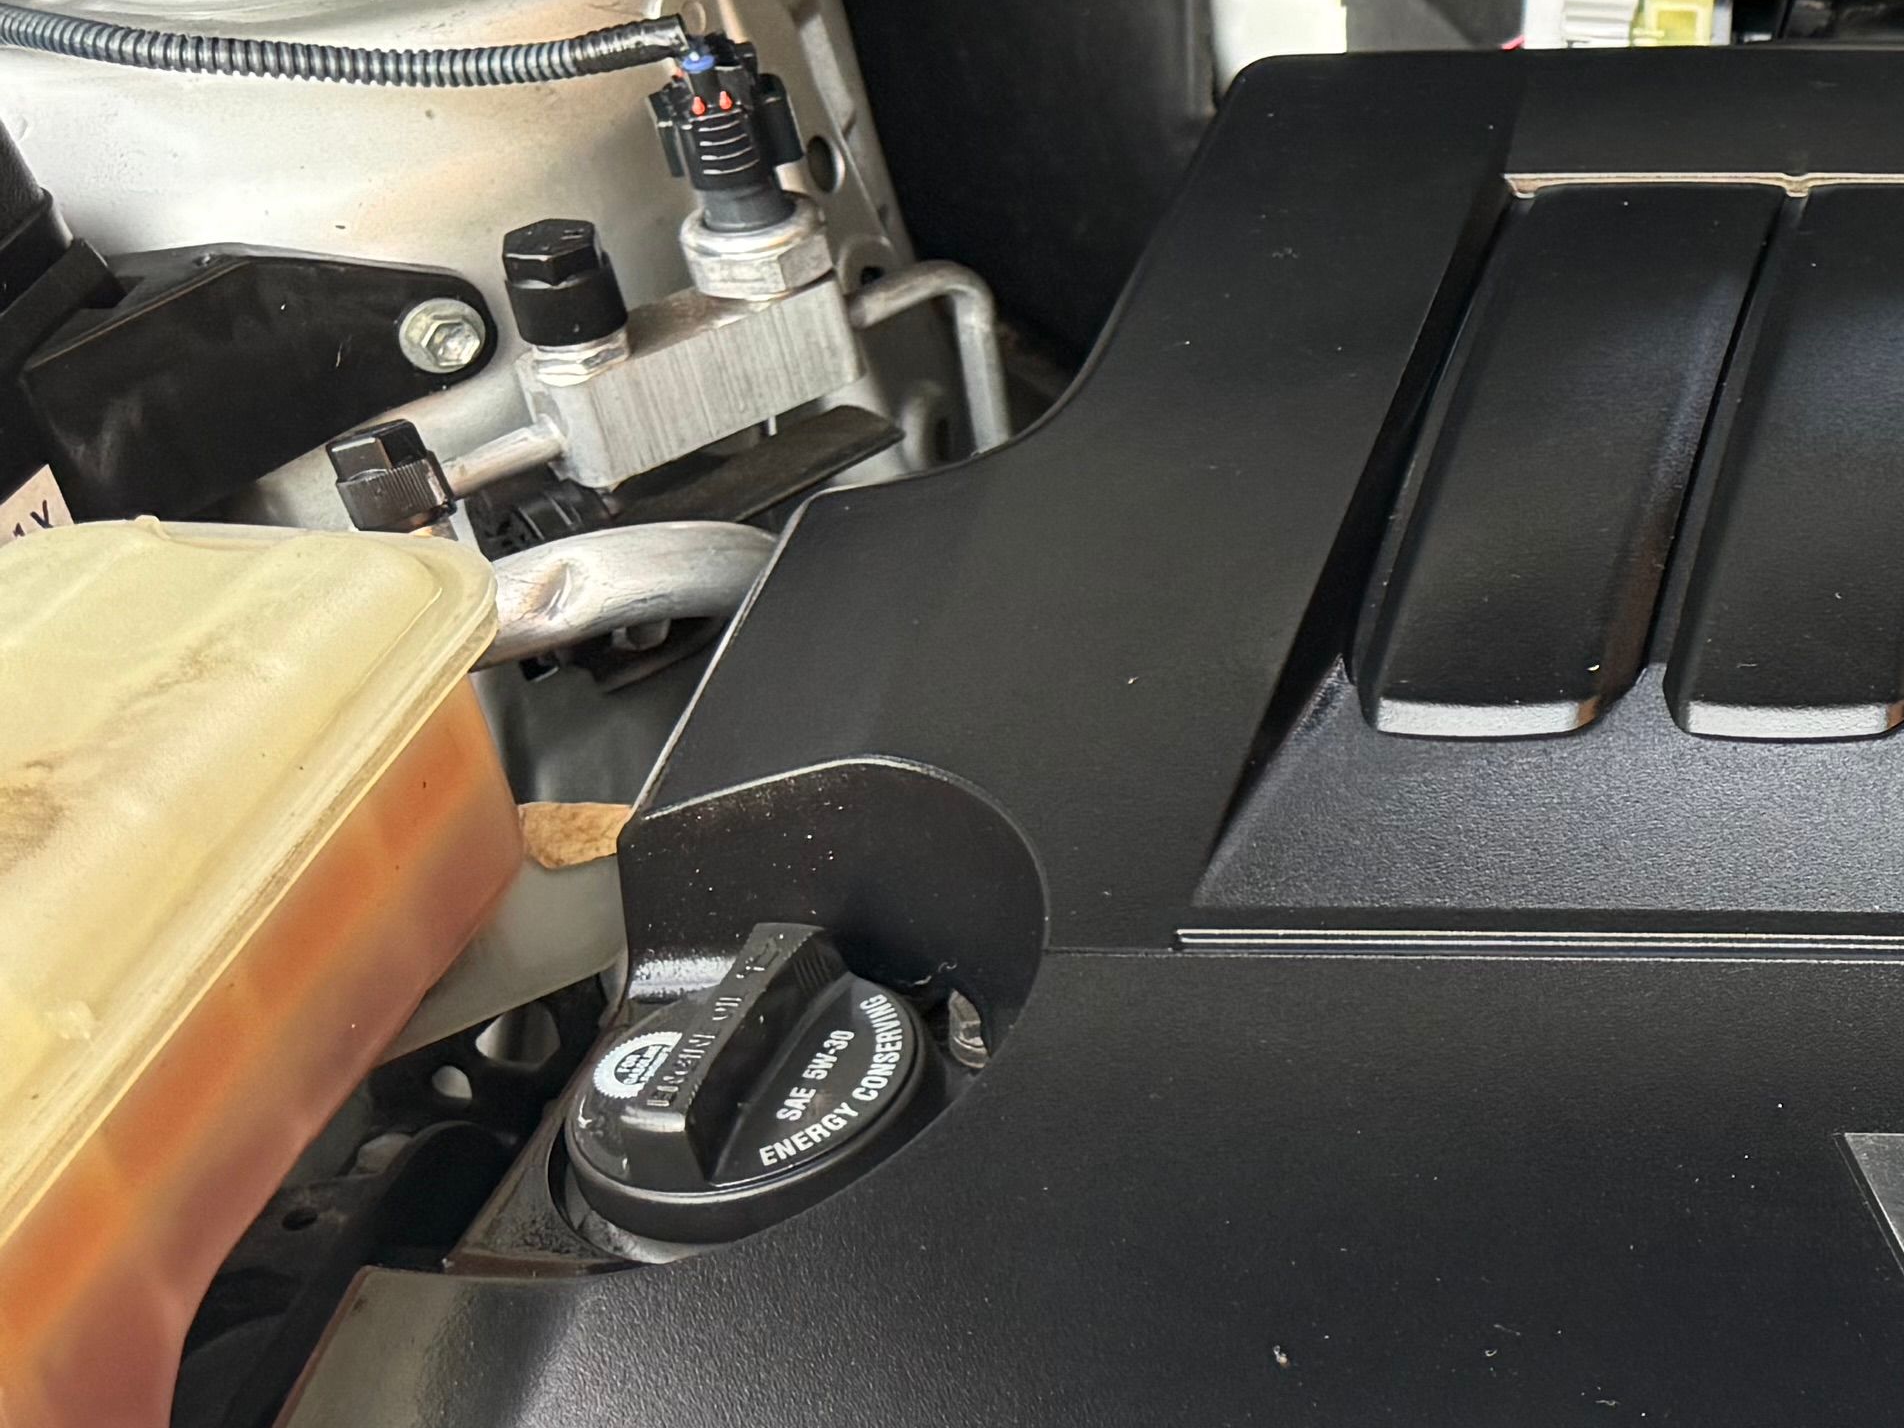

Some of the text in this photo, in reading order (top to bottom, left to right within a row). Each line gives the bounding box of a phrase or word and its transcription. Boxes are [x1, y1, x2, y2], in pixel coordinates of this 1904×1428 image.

[759, 994, 903, 1168] ENERGY CONSERVING
[776, 1029, 856, 1123] SAE 5W-30
